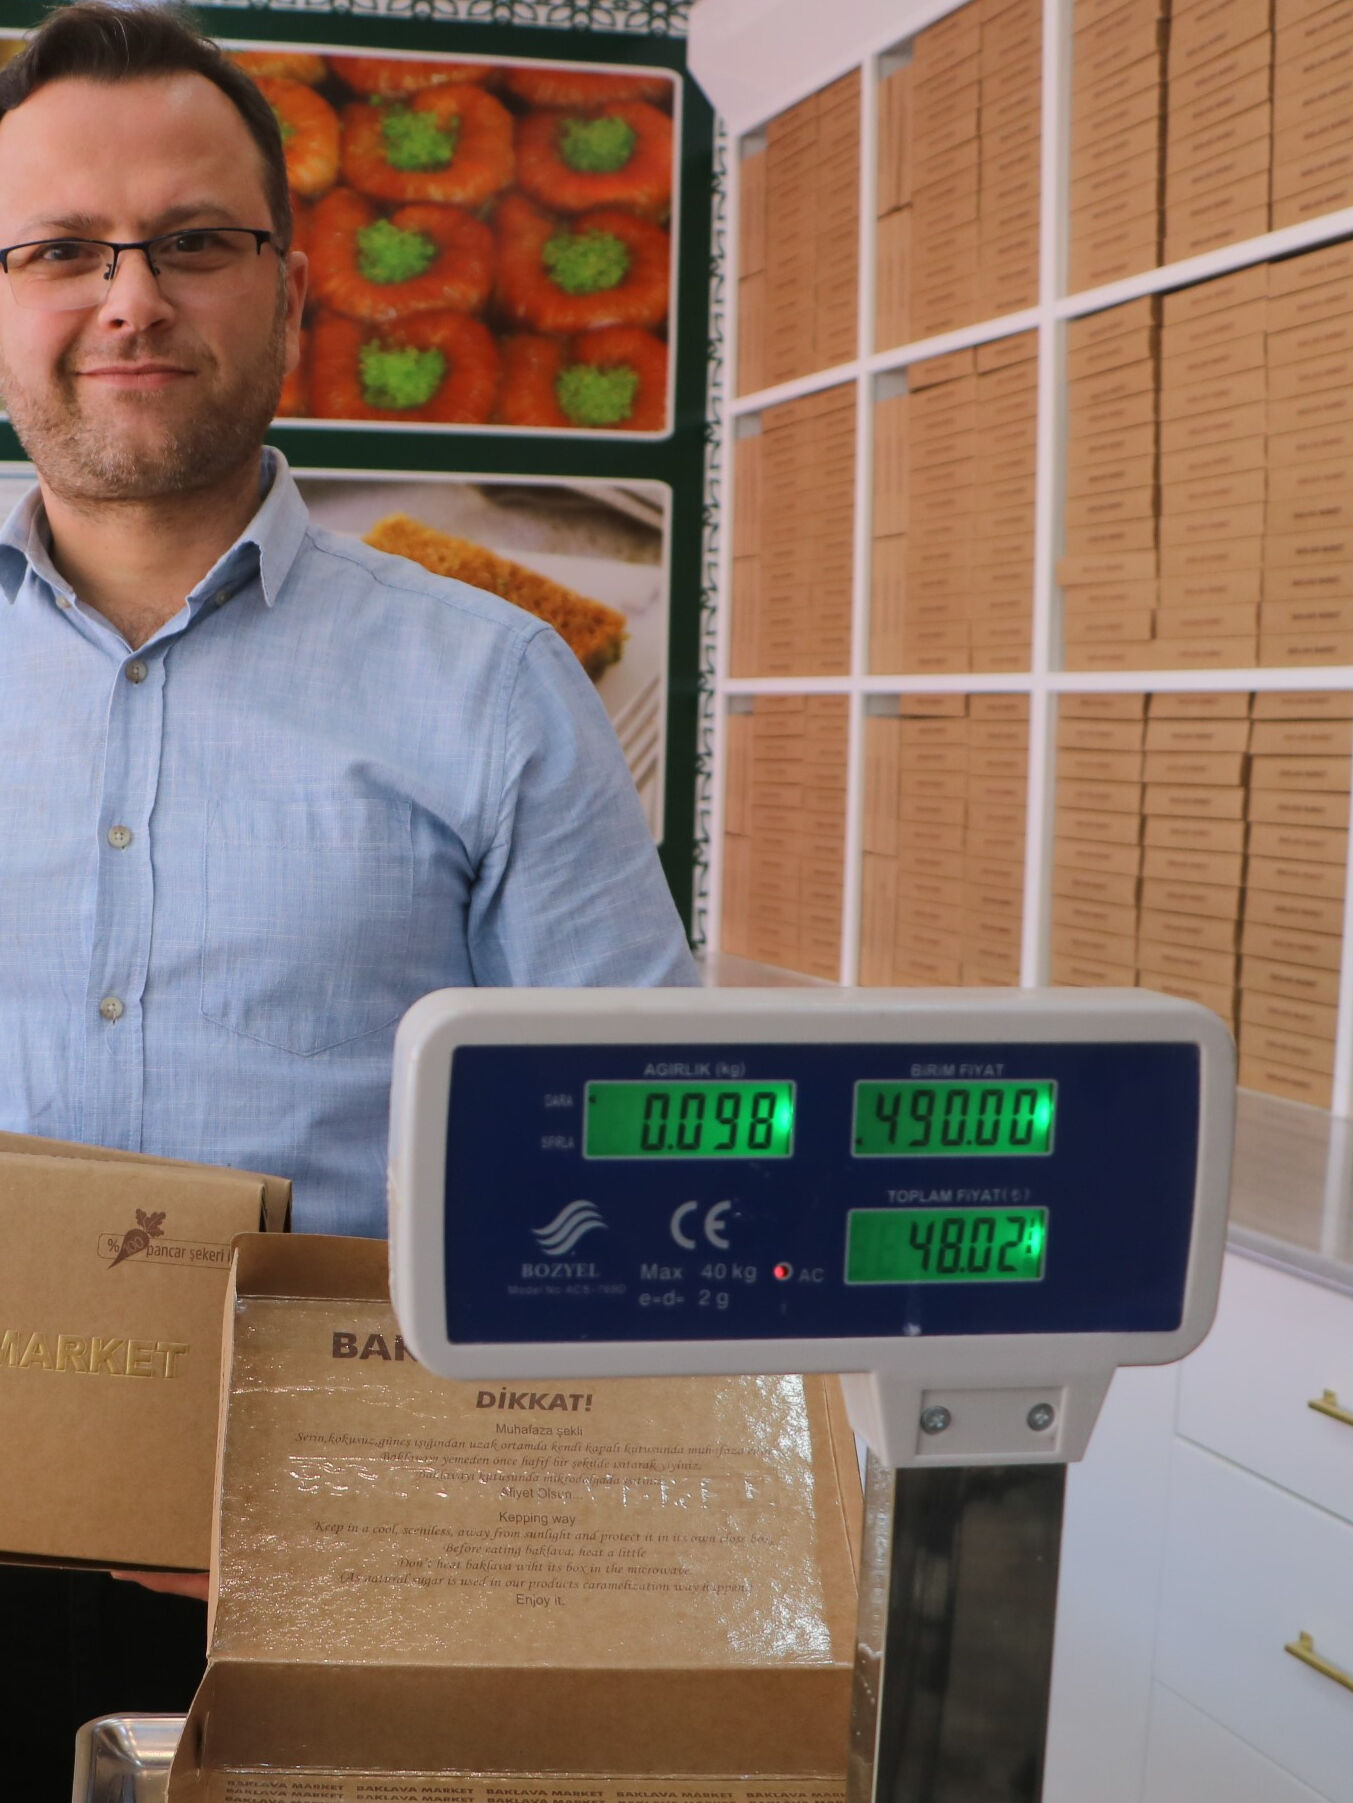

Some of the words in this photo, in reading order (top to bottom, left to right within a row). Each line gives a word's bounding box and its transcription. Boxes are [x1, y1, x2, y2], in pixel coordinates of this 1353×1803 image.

[640, 1092, 777, 1150] 0.098
[875, 1089, 1039, 1146] 490.00
[888, 1189, 952, 1202] TOPLAM
[670, 1200, 732, 1249] CE
[521, 1263, 601, 1278] BOZYEL
[640, 1263, 683, 1280] Max
[701, 1263, 727, 1279] 40
[731, 1263, 757, 1283] kg
[798, 1268, 824, 1282] AC
[476, 1386, 593, 1412] DİKKAT!
[496, 1424, 553, 1436] Muhafaza
[556, 1425, 584, 1437] şekli
[499, 1511, 549, 1526] Kepping
[551, 1514, 576, 1527] way
[574, 1530, 598, 1541] and
[516, 1594, 550, 1608] Enjoy
